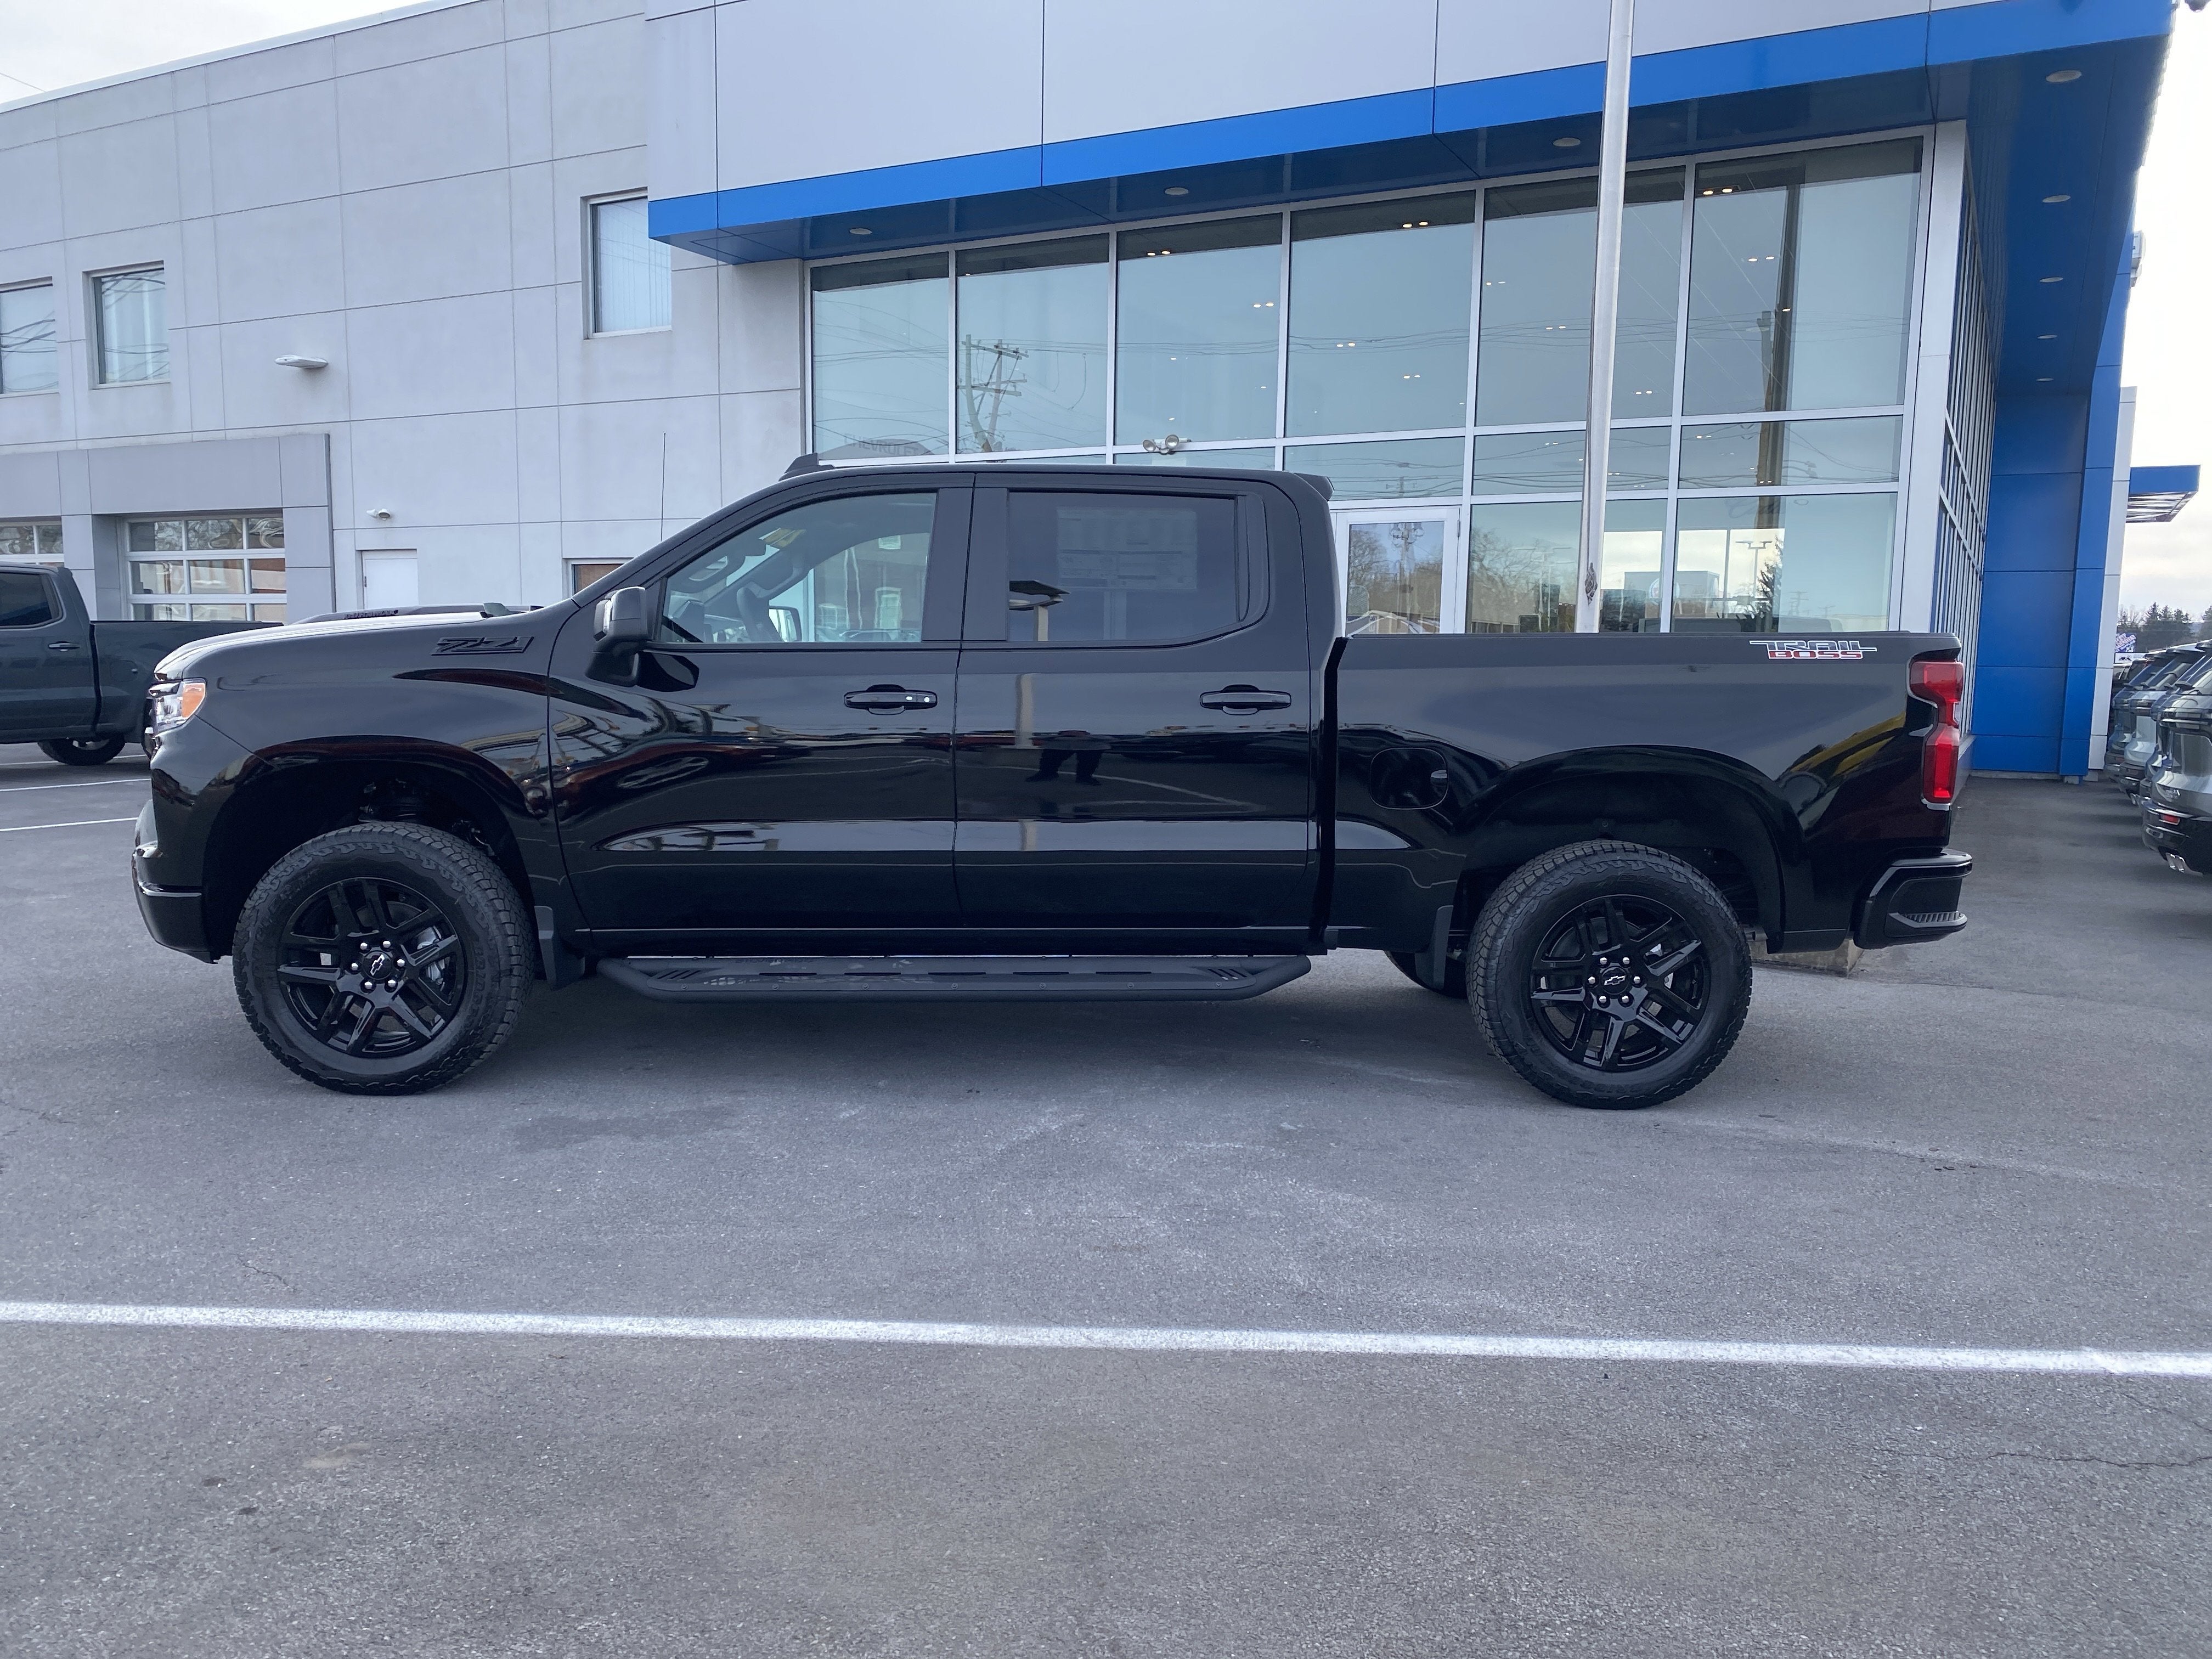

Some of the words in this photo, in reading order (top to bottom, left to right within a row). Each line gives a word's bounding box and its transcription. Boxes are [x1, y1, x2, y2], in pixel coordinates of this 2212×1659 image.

[431, 636, 534, 656] Z71
[1749, 640, 1877, 652] TRAIL
[1768, 651, 1863, 659] BOSS
